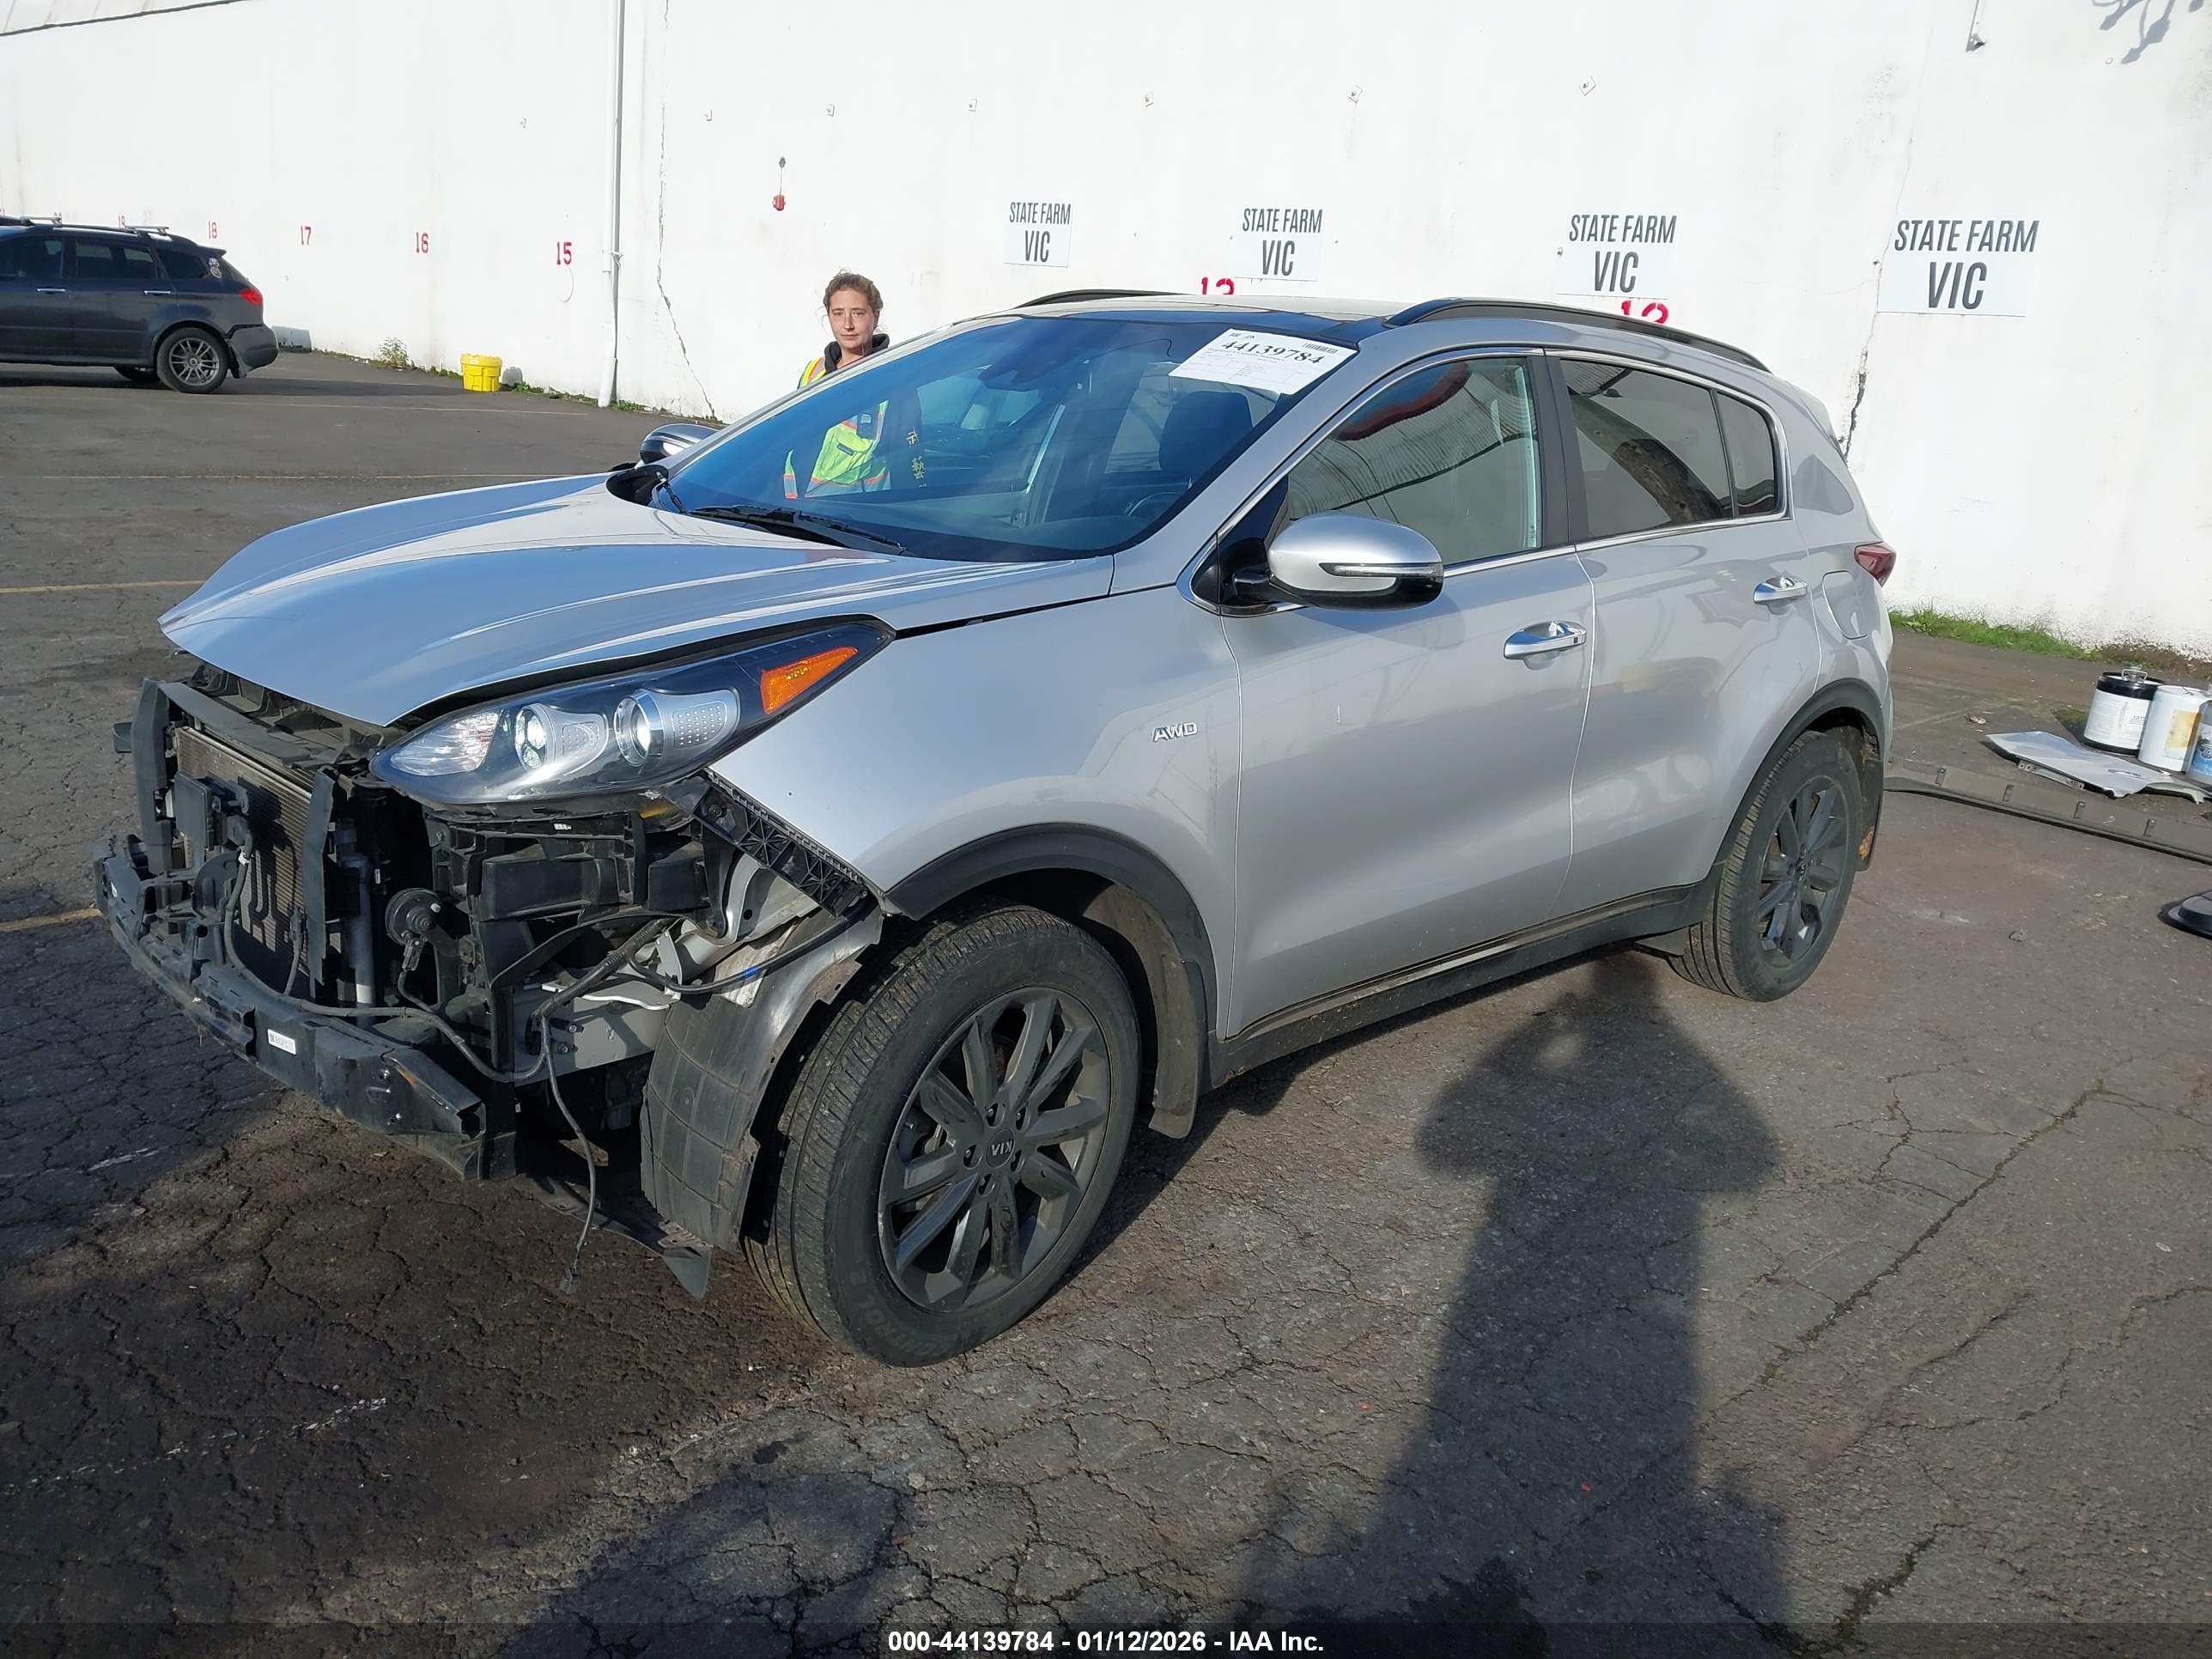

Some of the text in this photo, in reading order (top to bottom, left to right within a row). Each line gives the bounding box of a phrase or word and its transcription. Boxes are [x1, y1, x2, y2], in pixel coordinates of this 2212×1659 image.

[1009, 202, 1071, 225] STATE FARM
[1242, 208, 1322, 234] STATE FARM
[208, 221, 218, 240] 18
[300, 225, 312, 246] 17
[1569, 214, 1677, 244] STATE FARM
[1894, 220, 2039, 252] STATE FARM
[416, 232, 429, 253] 16
[556, 241, 573, 265] 15
[1024, 230, 1050, 263] VIC
[1262, 240, 1295, 276] VIC
[1594, 251, 1639, 294] VIC
[1928, 261, 1987, 310] VIC
[1222, 340, 1326, 364] 44139784
[1152, 721, 1198, 743] AWD
[990, 1139, 1013, 1157] KIA
